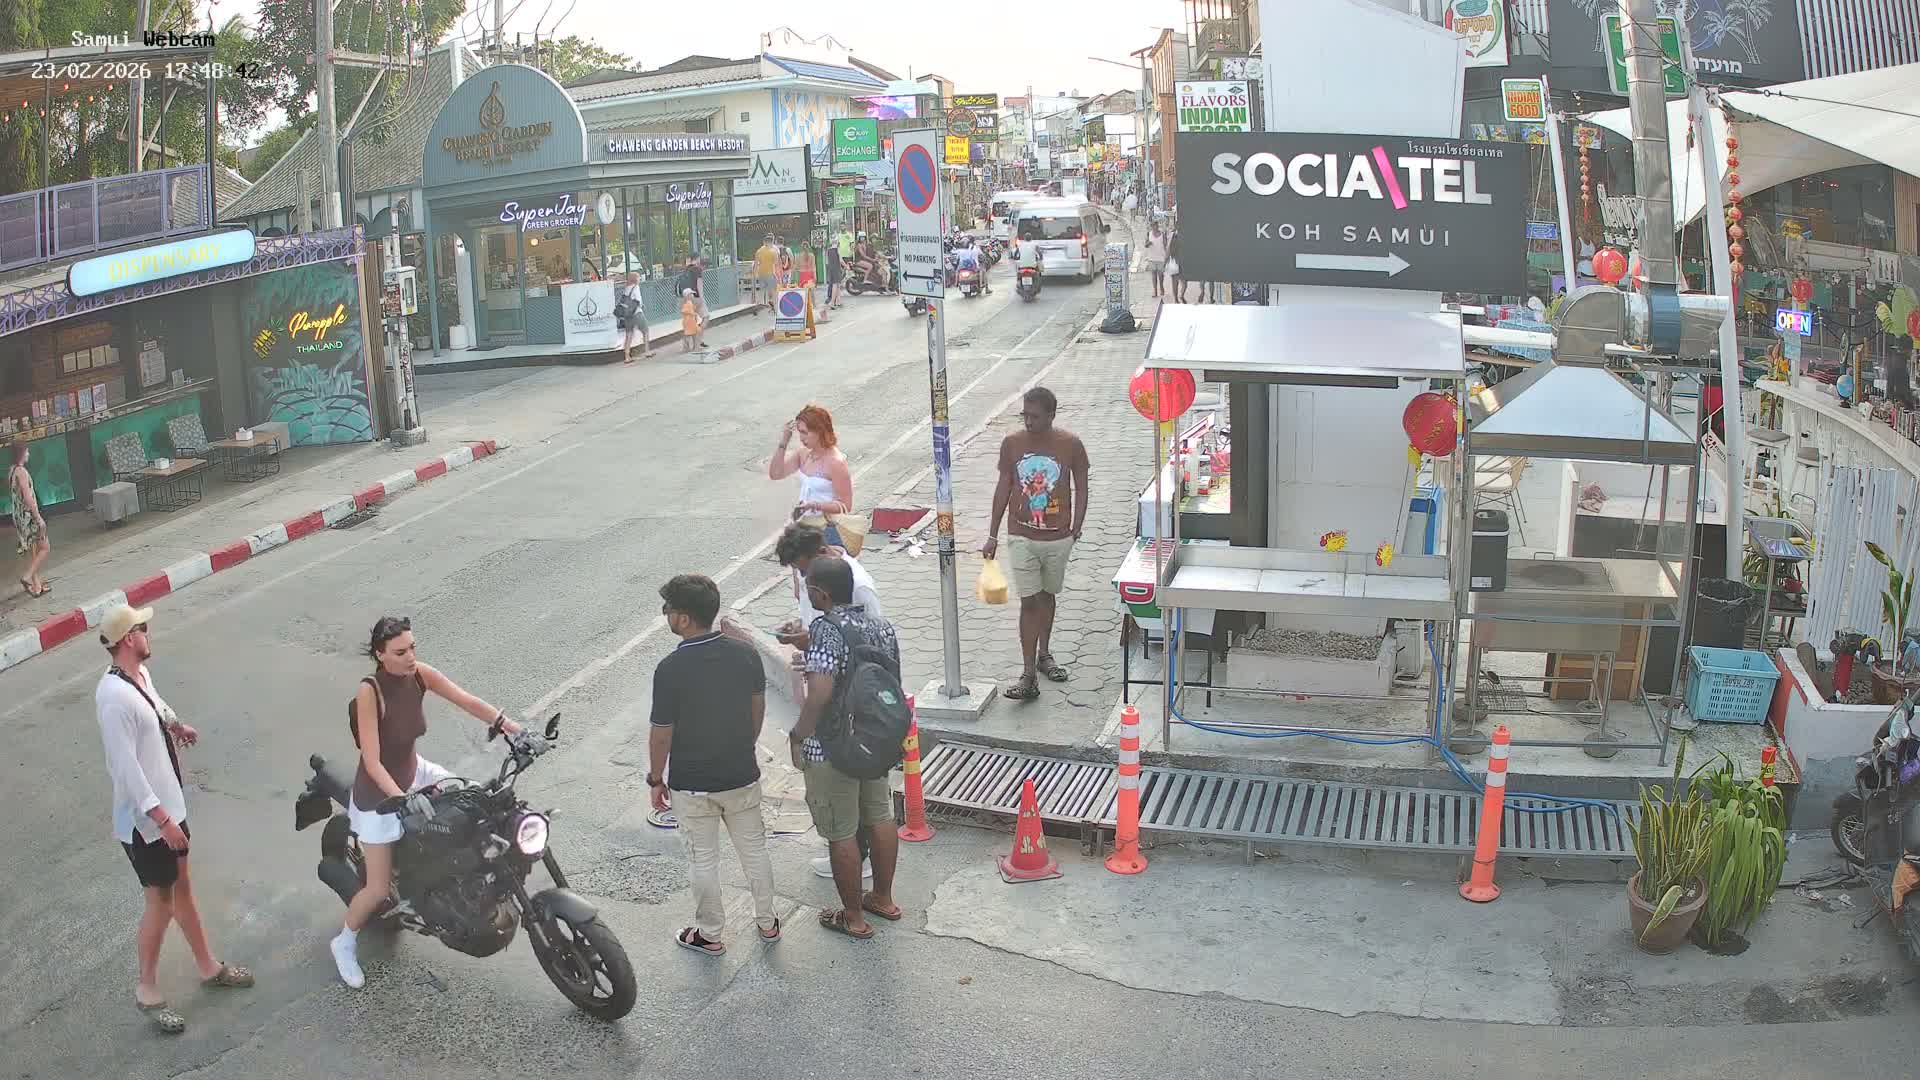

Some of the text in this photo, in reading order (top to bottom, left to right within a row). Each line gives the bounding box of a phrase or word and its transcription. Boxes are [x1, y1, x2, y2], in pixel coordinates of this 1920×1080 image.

[1181, 95, 1247, 107] FLAVORS
[1507, 91, 1540, 103] INDIAN
[1180, 107, 1247, 125] INDIAN
[1510, 104, 1539, 117] FOOD
[608, 138, 745, 152] CHAWENG GARDEN BEACH RESORT
[836, 145, 878, 156] EXCHANGE
[1407, 140, 1504, 158] โรงแรมโซเชียลเทล
[666, 181, 712, 212] SuperJay
[499, 194, 587, 233] SuperJay
[526, 217, 579, 229] GREEN GROCER
[1255, 223, 1449, 246] KOH SAMUI
[108, 241, 221, 282] DISPENSARY
[904, 254, 937, 264] NO PARKING
[1778, 312, 1810, 332] OPEN
[296, 341, 344, 353] THAILAND
